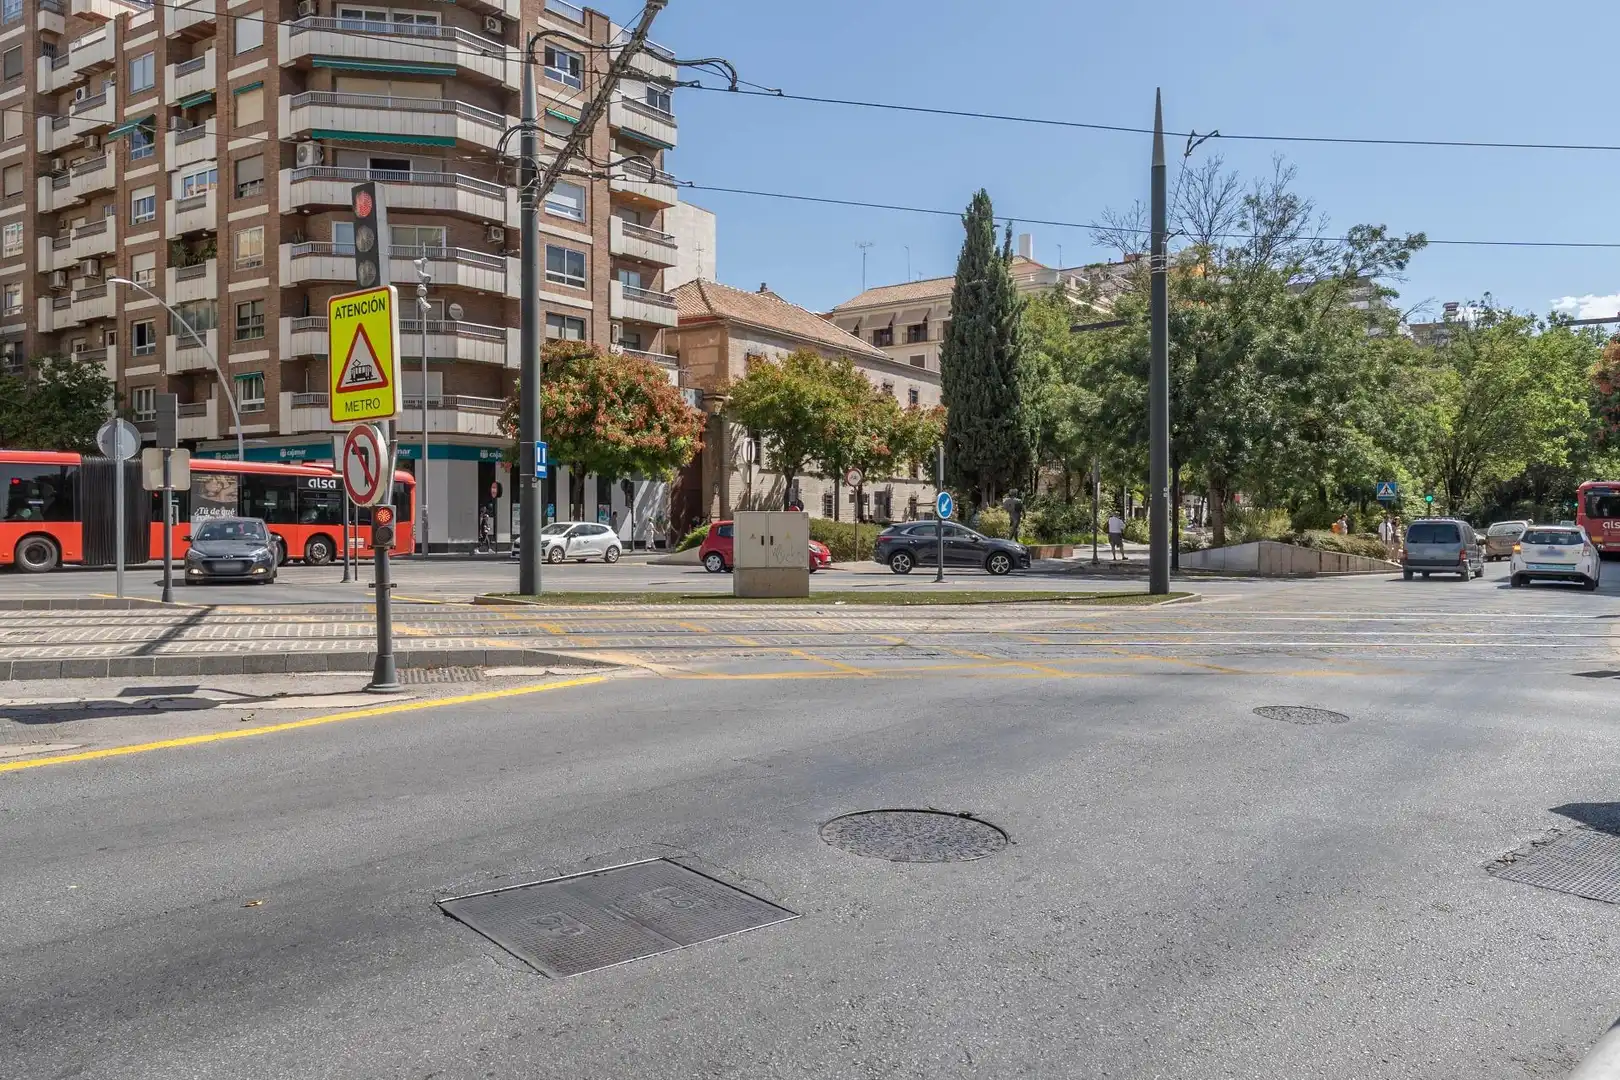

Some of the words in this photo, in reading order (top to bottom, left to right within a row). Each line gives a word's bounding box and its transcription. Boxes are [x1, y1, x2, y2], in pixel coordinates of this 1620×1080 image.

[334, 296, 386, 320] ATENCIÓN
[345, 397, 381, 412] METRO
[308, 477, 337, 489] alsa
[209, 507, 220, 515] de
